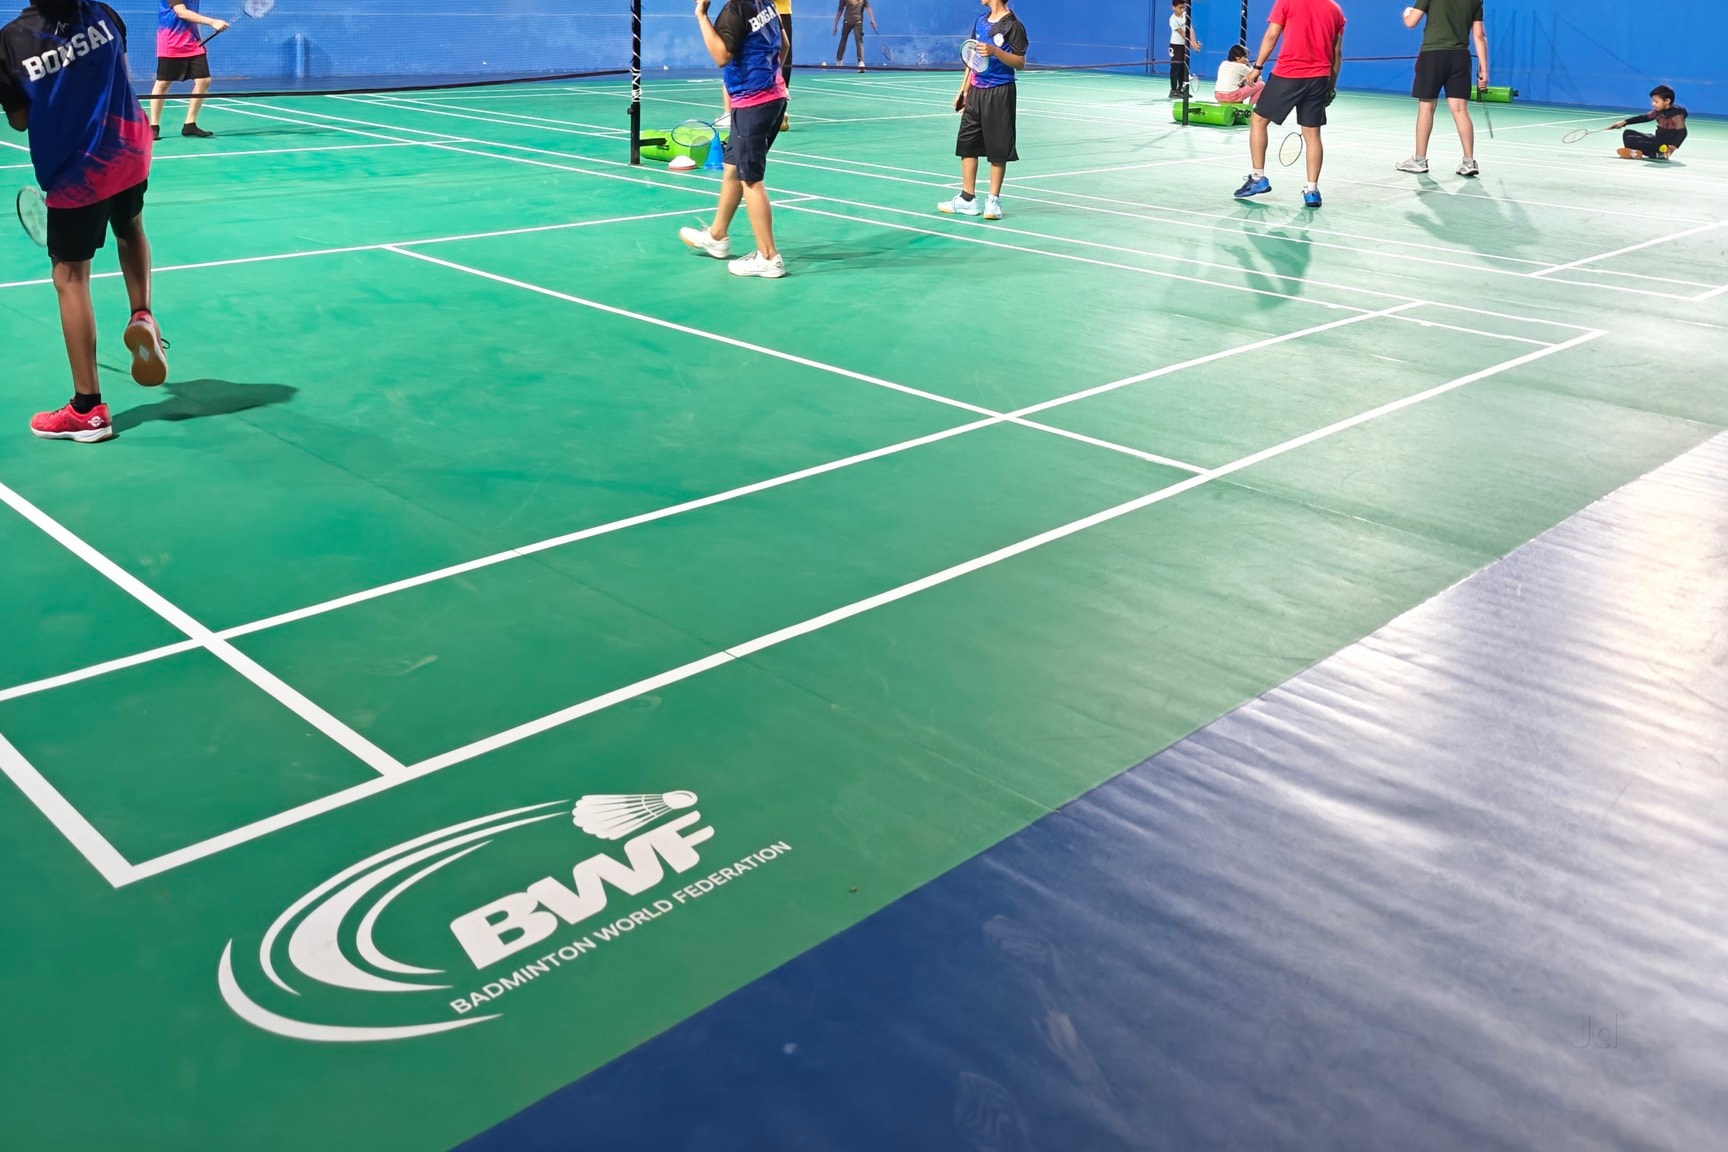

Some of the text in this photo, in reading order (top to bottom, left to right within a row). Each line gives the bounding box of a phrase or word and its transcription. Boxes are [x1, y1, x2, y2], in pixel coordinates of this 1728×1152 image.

[22, 20, 114, 82] BONSAI
[449, 810, 715, 970] BWF
[449, 840, 793, 1015] BADMINTON WORLD FEDERATION
